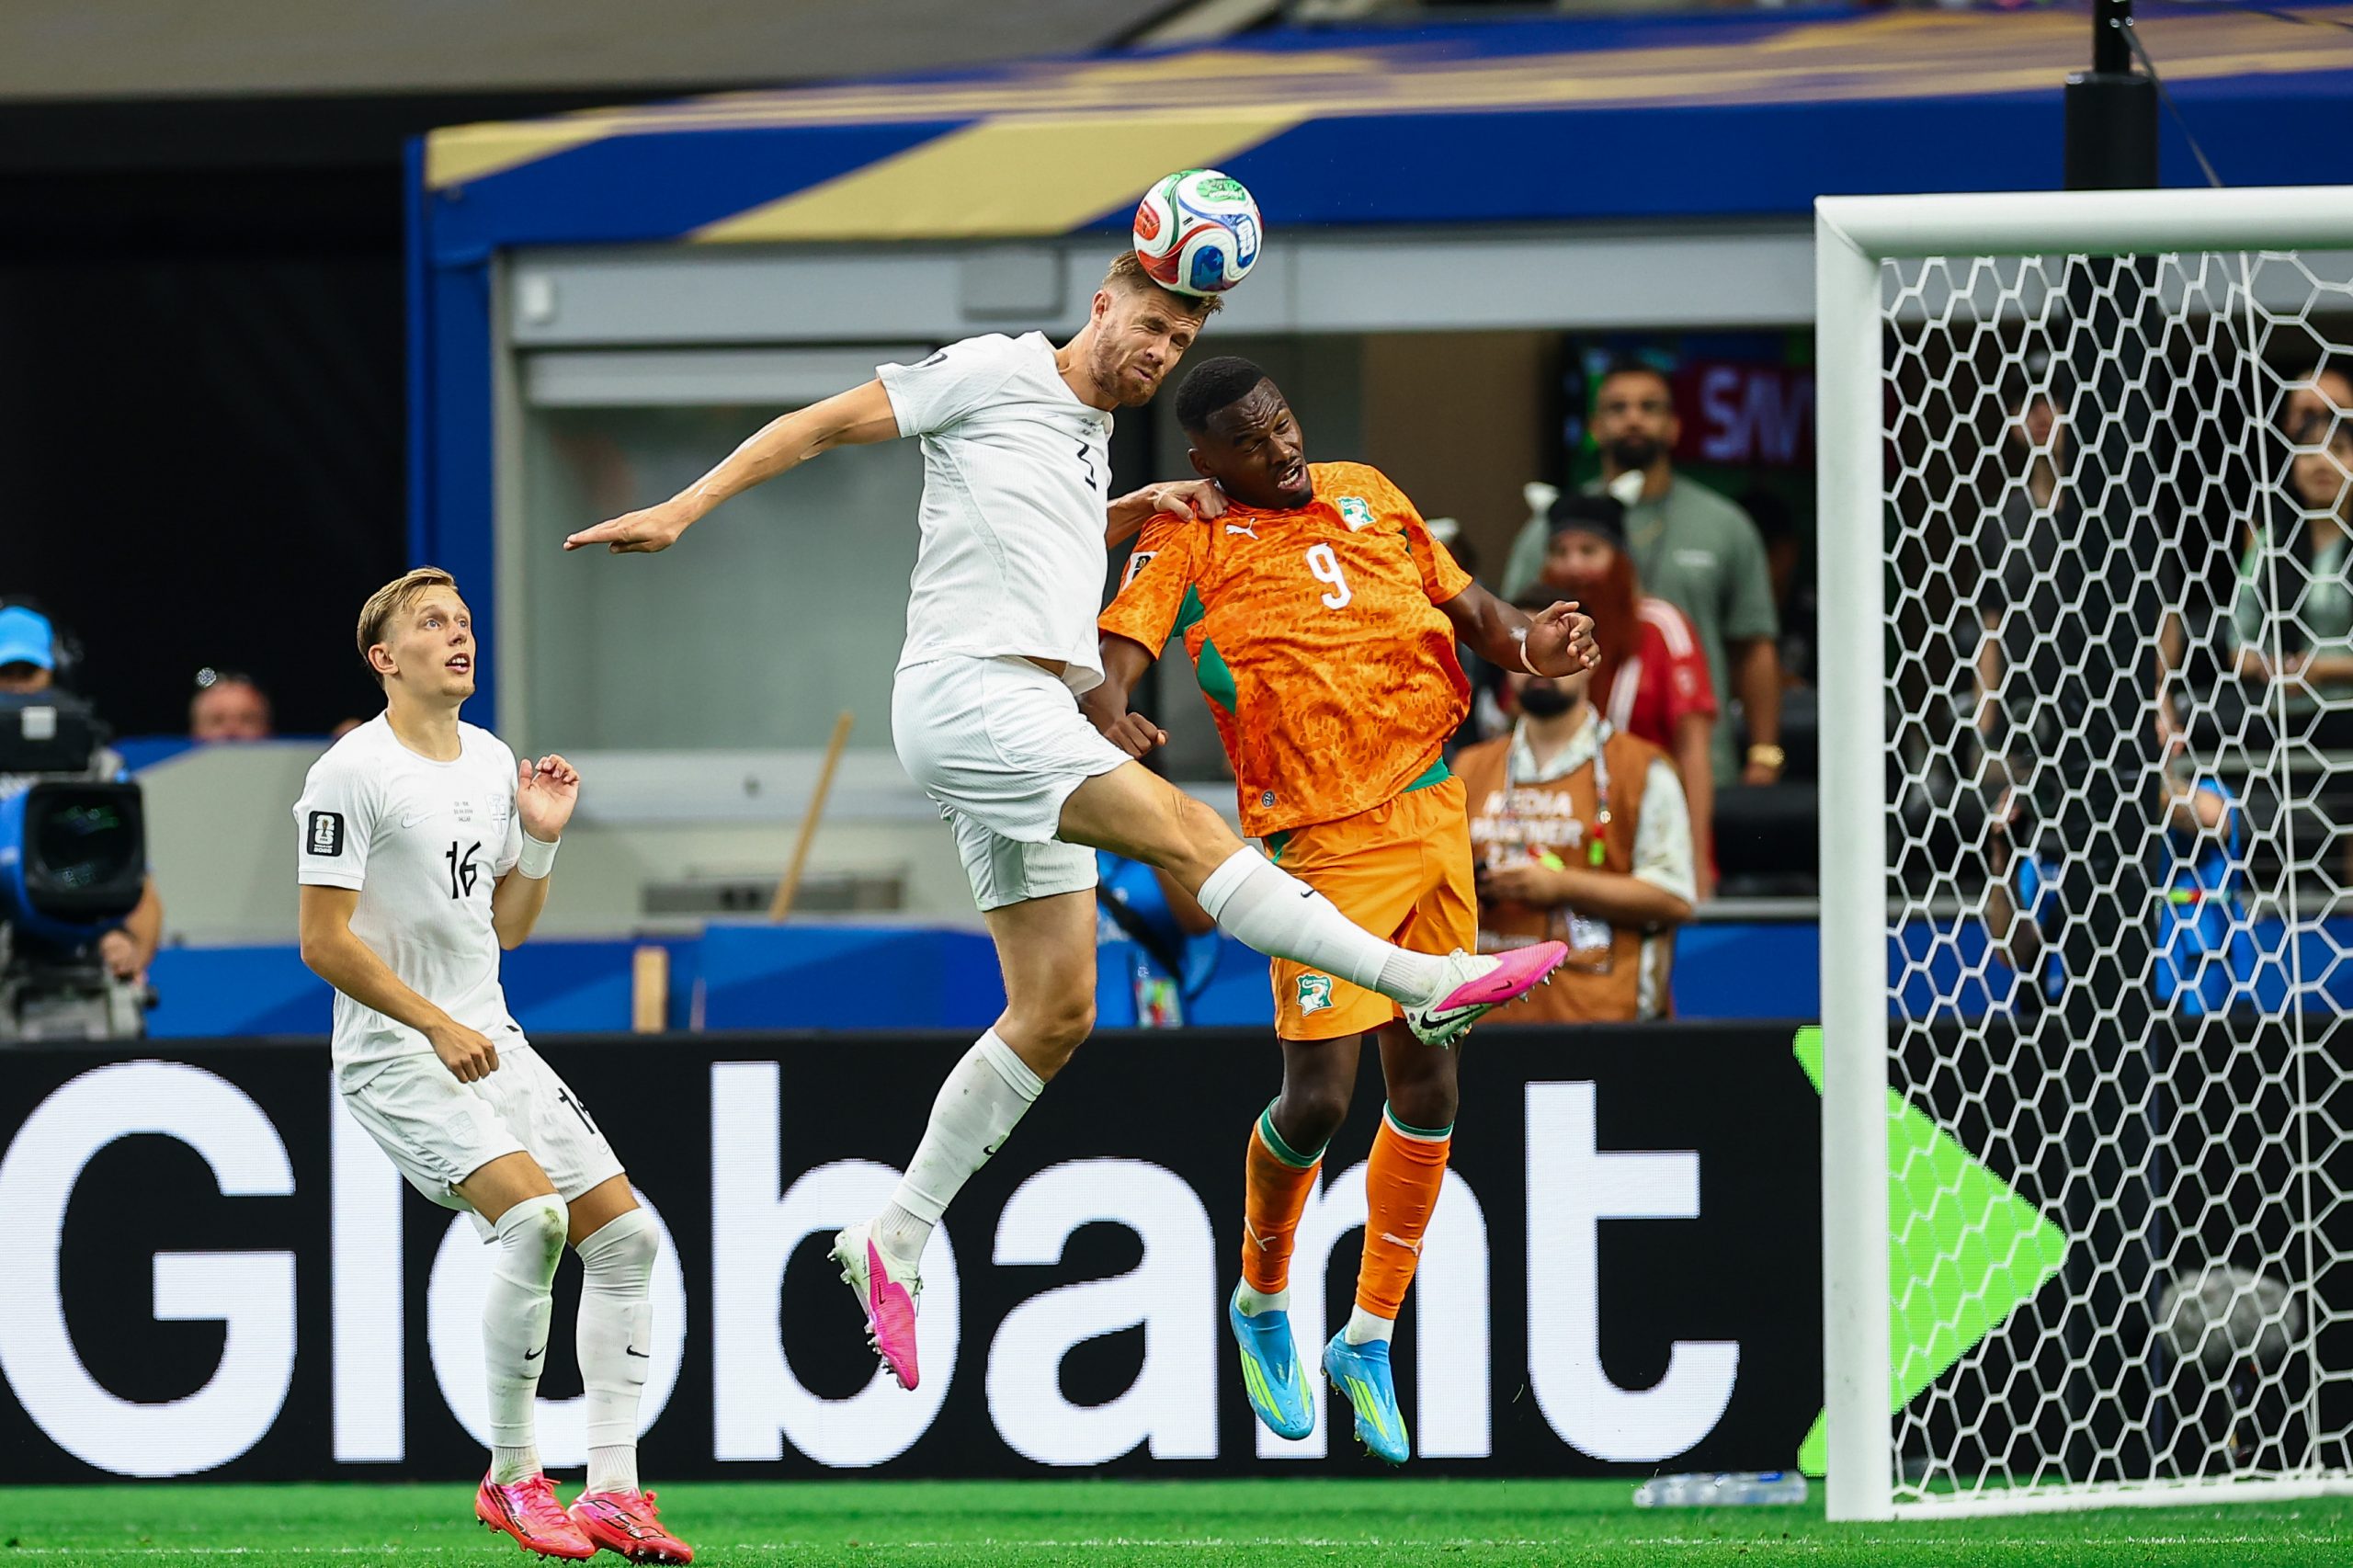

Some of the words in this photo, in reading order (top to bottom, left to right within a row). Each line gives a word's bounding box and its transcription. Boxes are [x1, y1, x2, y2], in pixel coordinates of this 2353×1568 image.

[1304, 542, 1353, 610] 9
[446, 840, 482, 900] 16
[0, 1059, 1740, 1478] Globant
